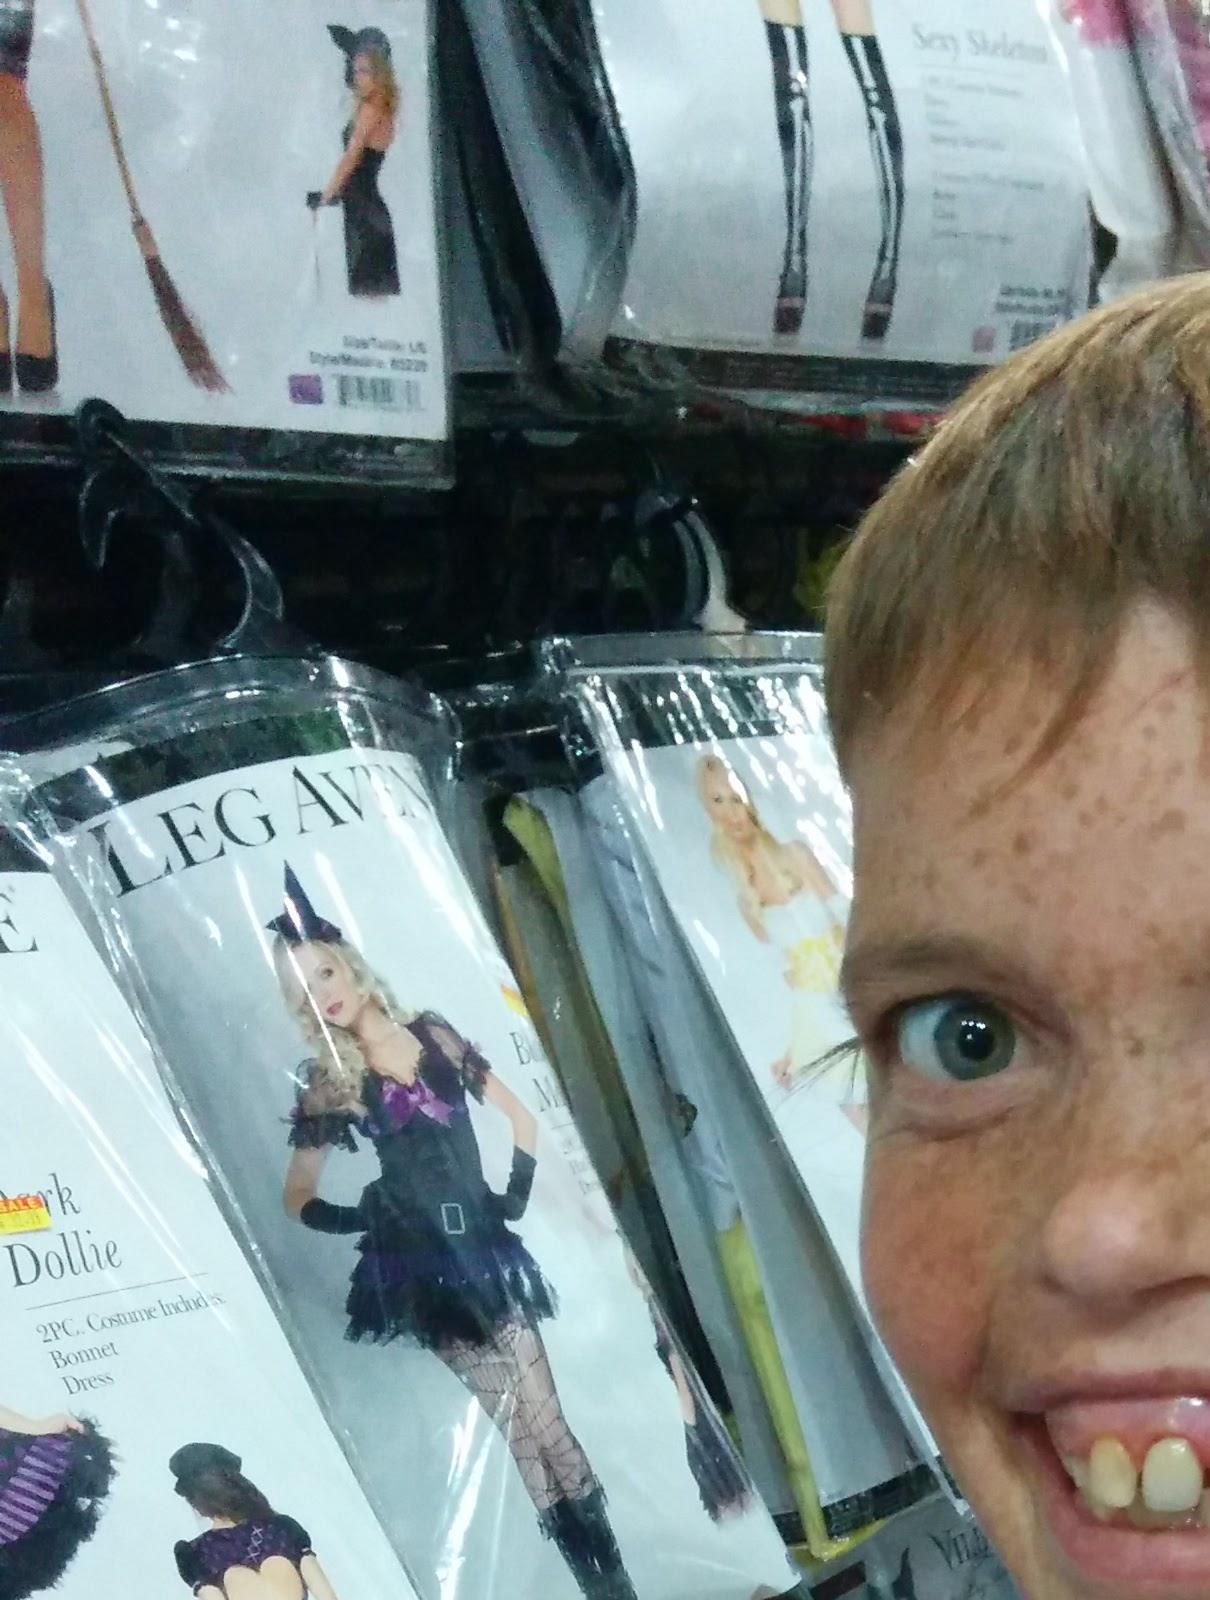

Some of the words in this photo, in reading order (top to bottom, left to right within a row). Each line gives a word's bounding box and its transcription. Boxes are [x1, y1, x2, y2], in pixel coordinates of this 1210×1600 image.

[87, 787, 277, 898] LEG
[3, 1229, 122, 1288] Dollie
[86, 1307, 158, 1333] Costume
[50, 1341, 119, 1370] Bonnet
[62, 1371, 115, 1396] Dress
